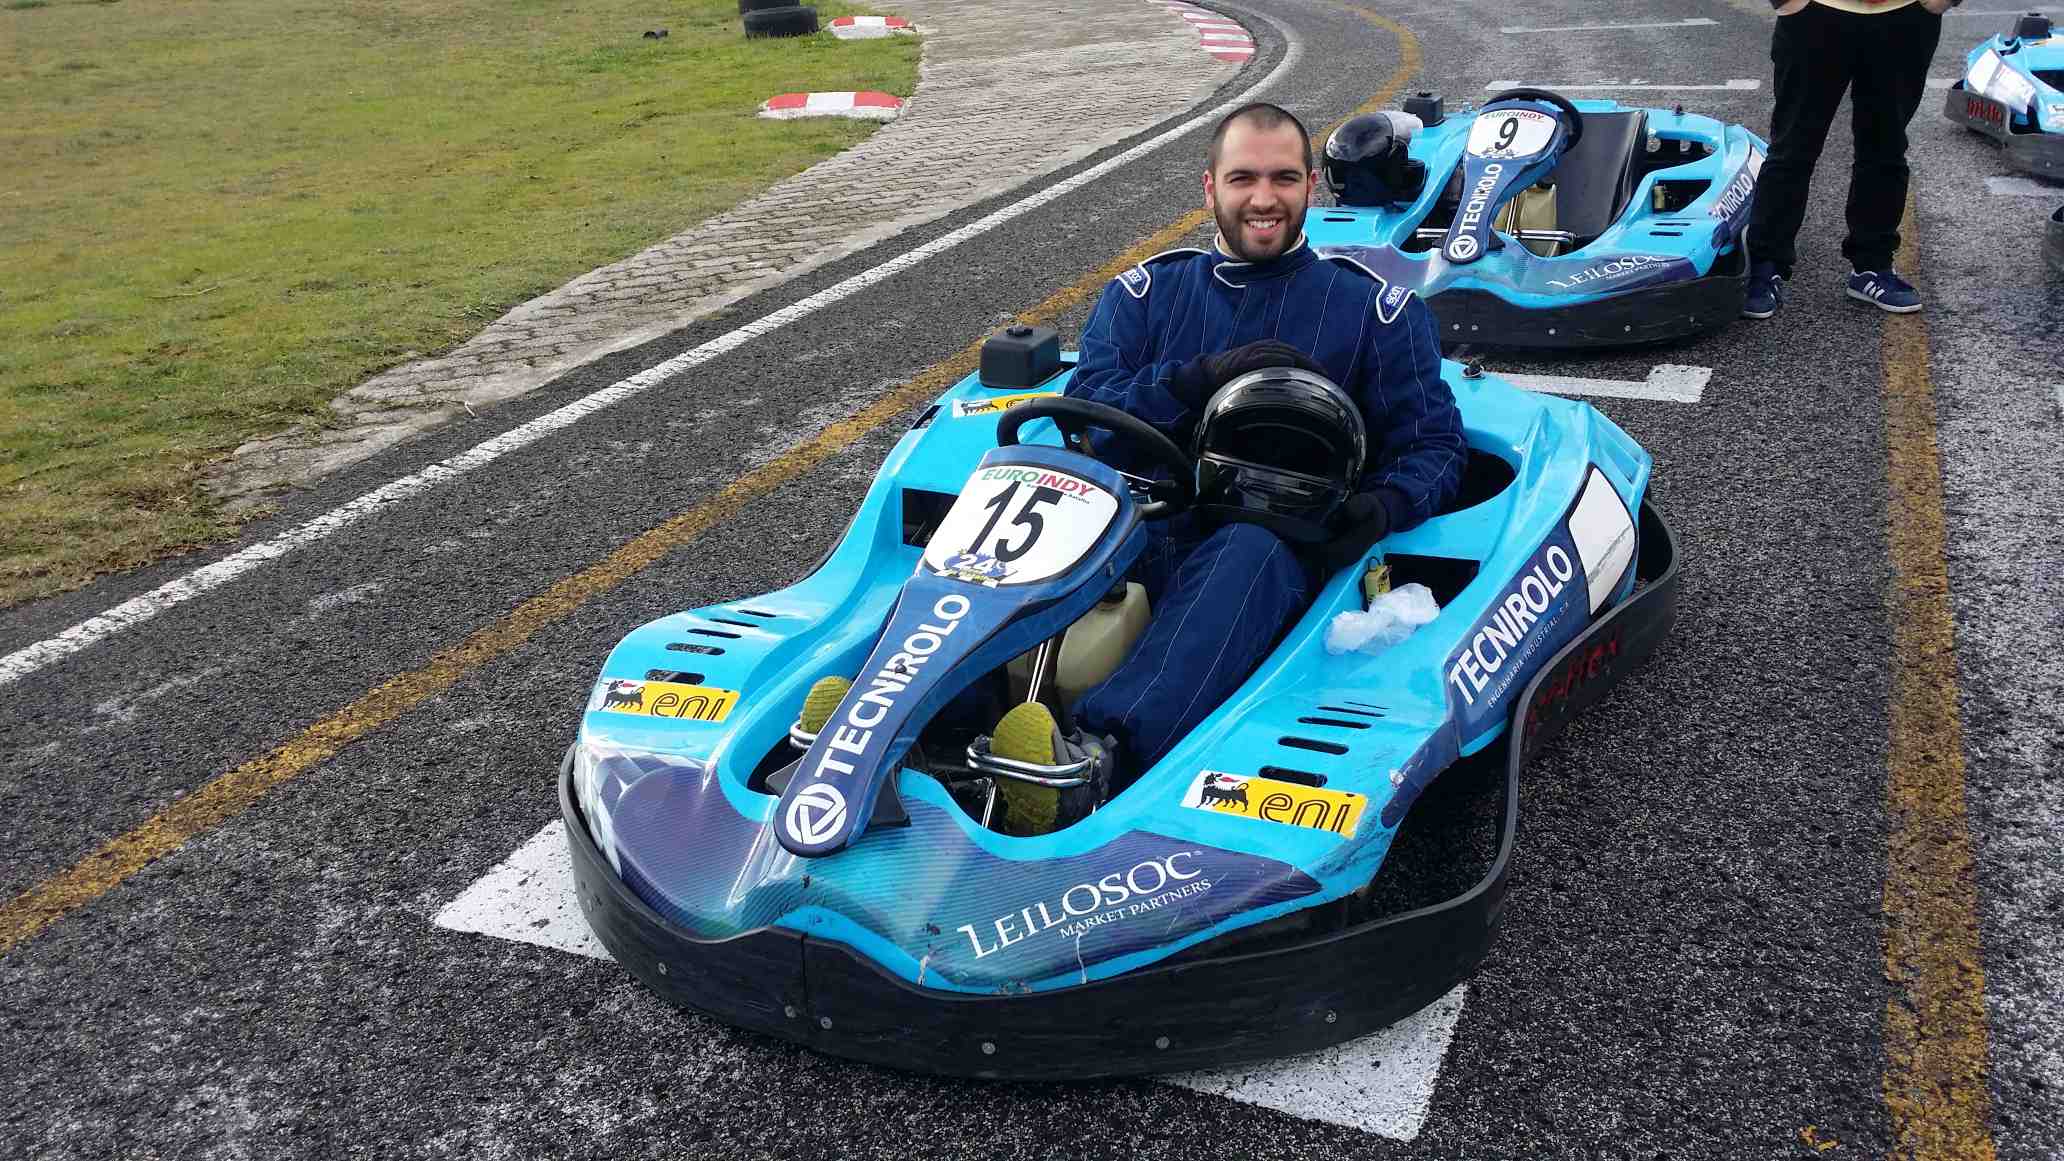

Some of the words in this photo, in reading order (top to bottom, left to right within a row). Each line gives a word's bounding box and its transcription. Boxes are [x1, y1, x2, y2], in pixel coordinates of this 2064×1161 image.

[1494, 117, 1519, 150] 9
[1458, 162, 1503, 234] TECNIROLO
[981, 468, 1096, 496] EUROINDY
[983, 480, 1066, 562] 15
[1449, 545, 1574, 705] TECNIROLO
[650, 688, 731, 722] eni
[815, 593, 972, 778] TECNIROLO
[1258, 792, 1357, 835] eni
[957, 850, 1203, 960] LEILOSOC
[1060, 907, 1131, 940] MARKET
[1130, 878, 1212, 916] PARTNERS
